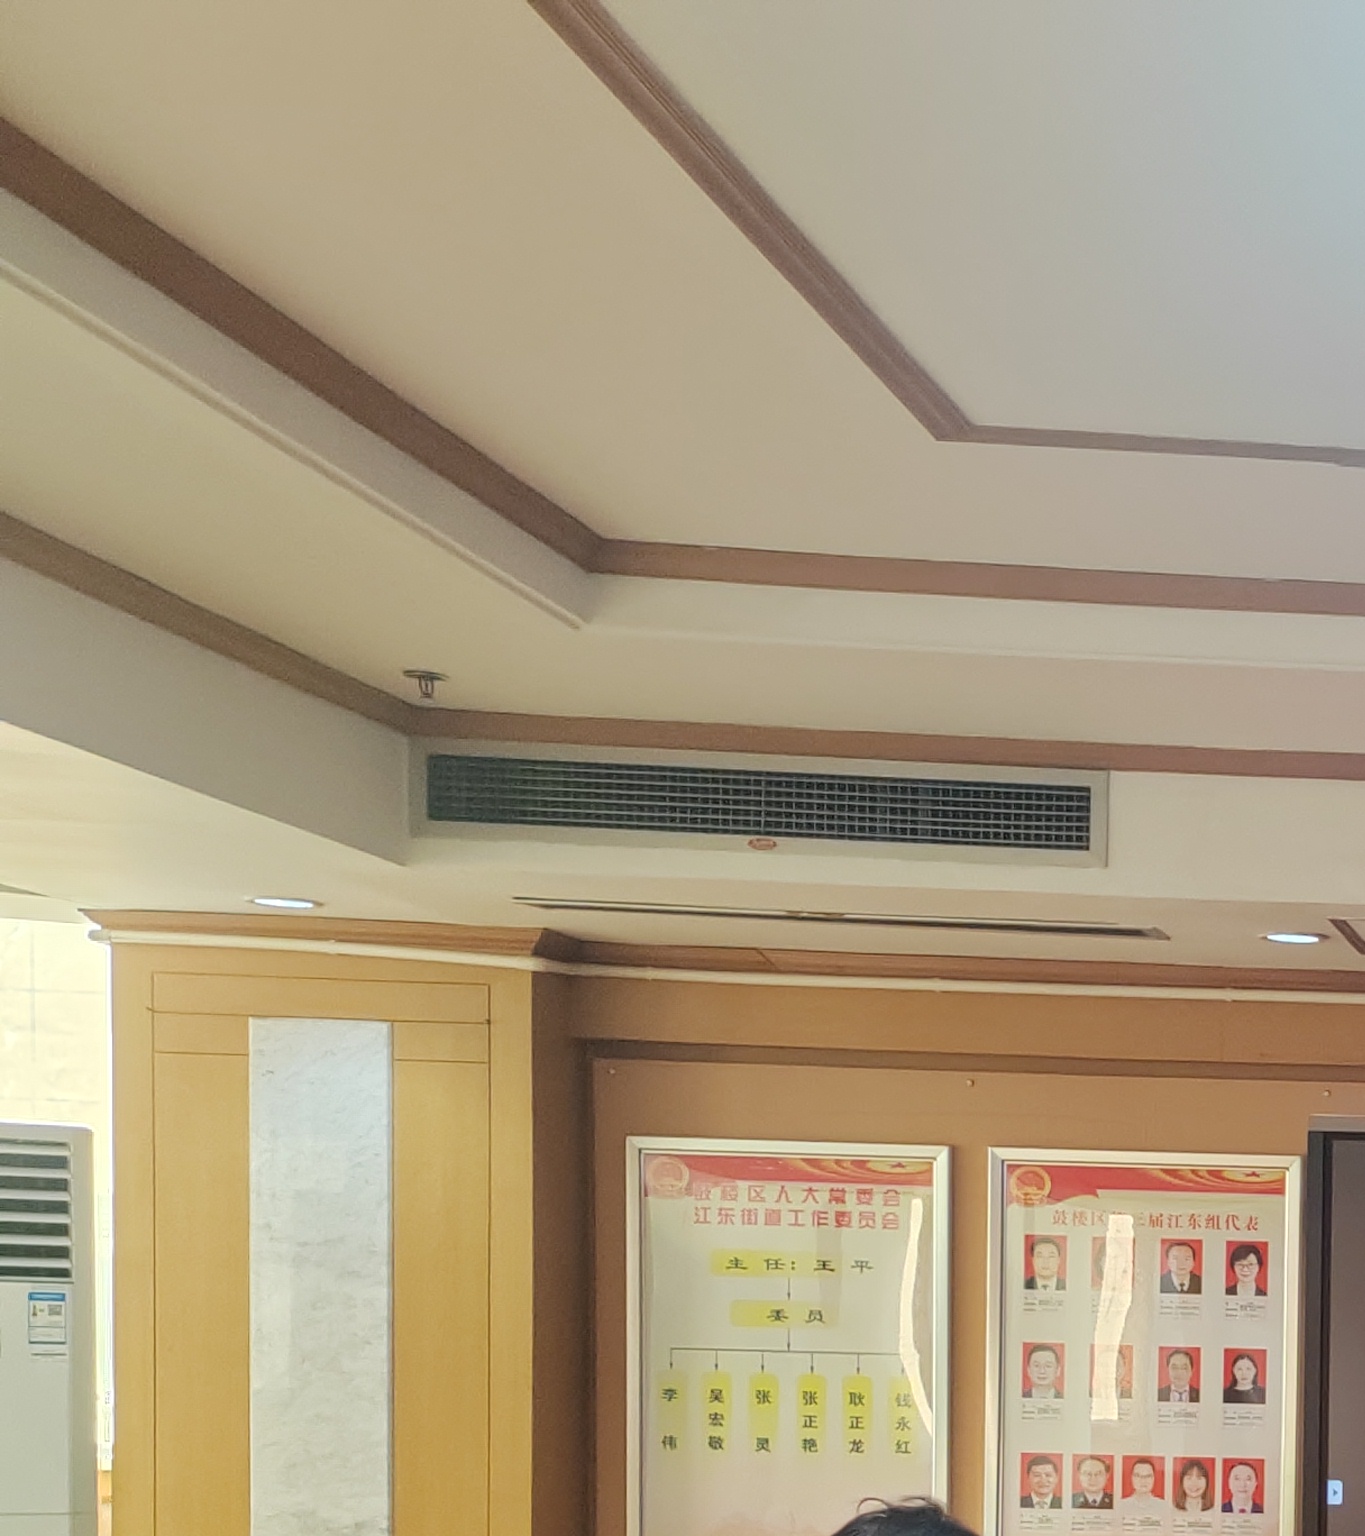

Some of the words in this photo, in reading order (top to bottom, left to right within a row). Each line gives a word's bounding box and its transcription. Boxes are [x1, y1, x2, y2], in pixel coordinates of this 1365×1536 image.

[694, 1207, 899, 1230] 江东街道工作委员会
[1052, 1209, 1259, 1231] 鼓楼区三届江东组代表
[766, 1309, 826, 1324] 委员
